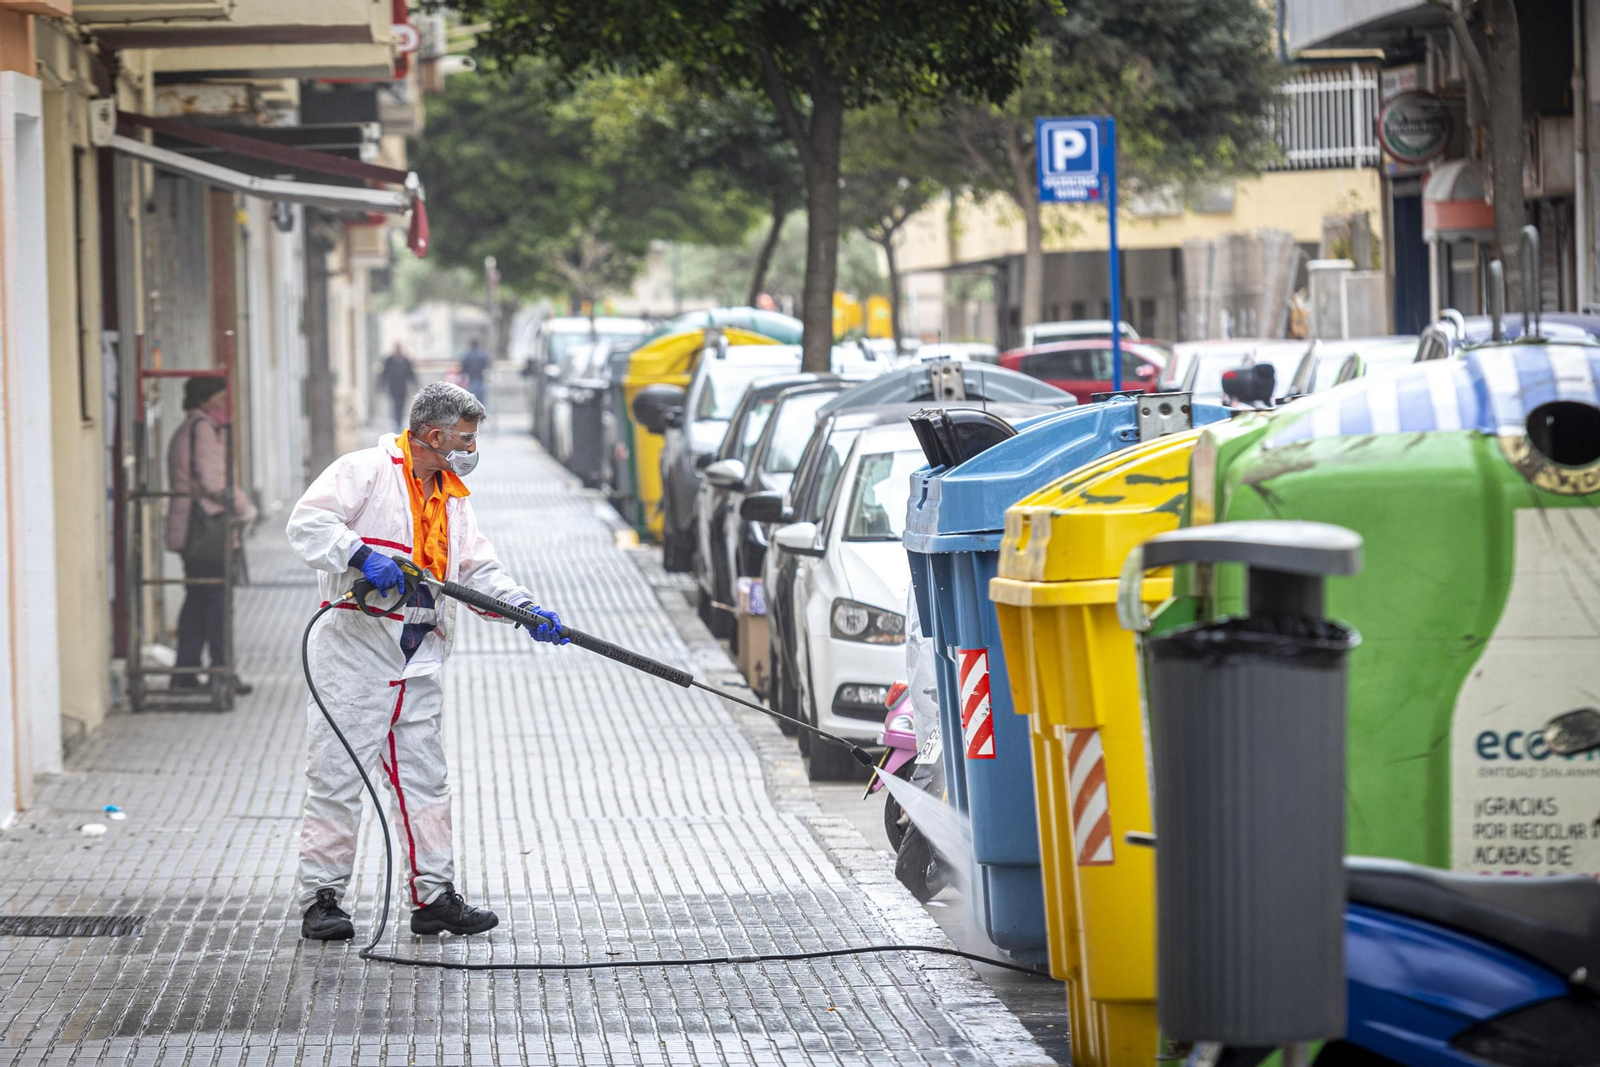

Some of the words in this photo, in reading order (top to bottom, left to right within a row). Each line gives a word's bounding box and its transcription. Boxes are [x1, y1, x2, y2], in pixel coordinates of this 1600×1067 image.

[1053, 129, 1087, 171] P
[1473, 823, 1507, 840] POR
[1510, 823, 1588, 840] RECICLAR
[1473, 845, 1543, 866] ACABAS
[1546, 845, 1573, 866] DE
